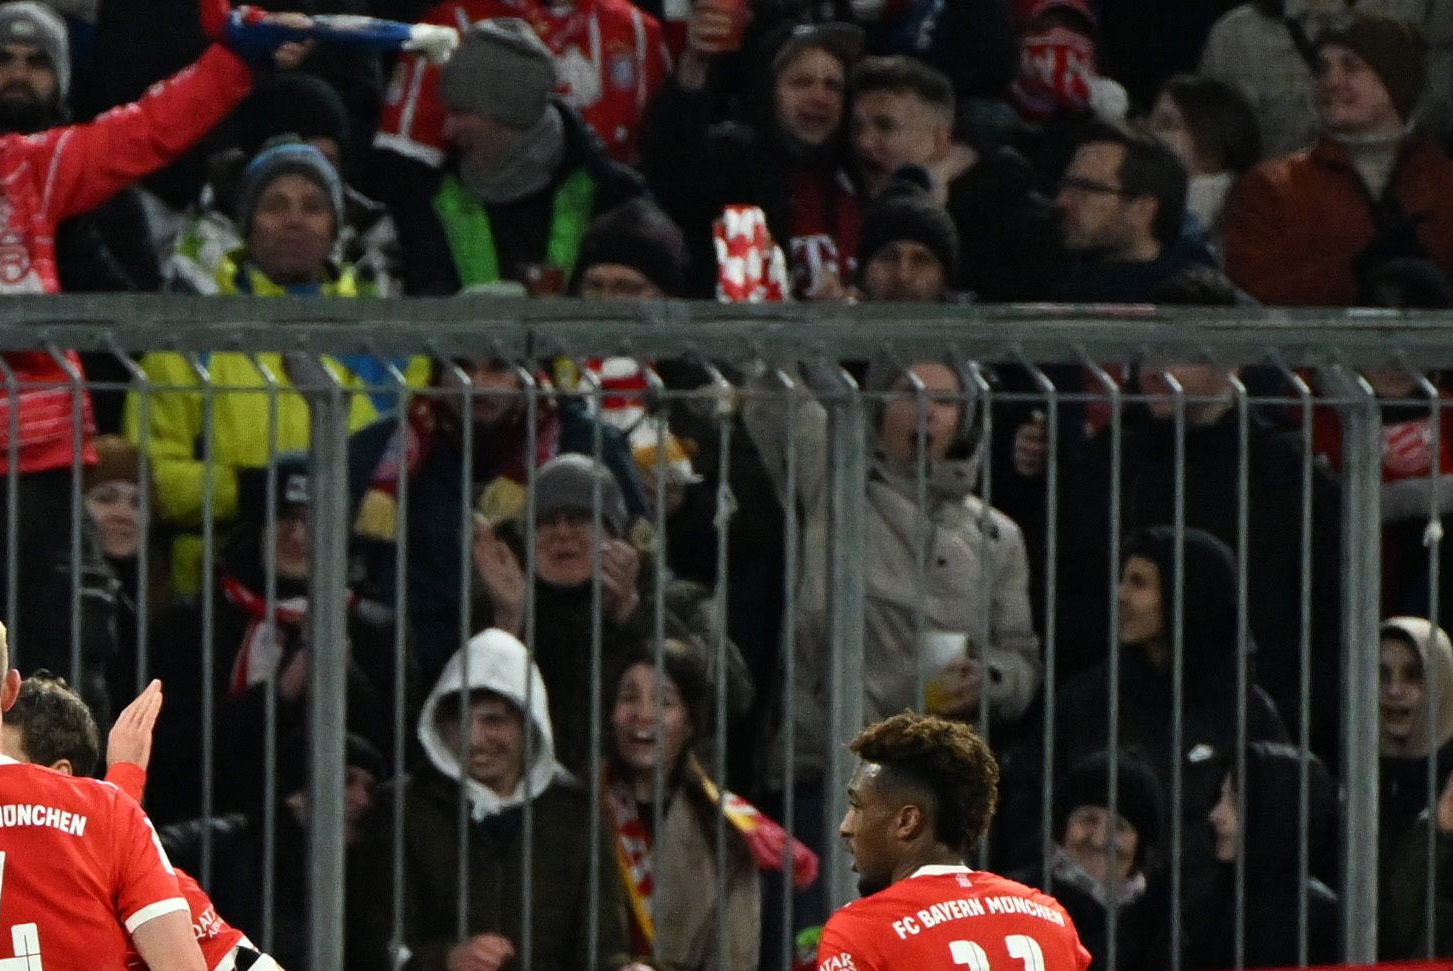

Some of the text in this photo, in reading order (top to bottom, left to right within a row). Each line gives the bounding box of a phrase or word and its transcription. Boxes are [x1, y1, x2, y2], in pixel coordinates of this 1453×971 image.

[892, 895, 1065, 940] FC BAYERN MÜNCHEN
